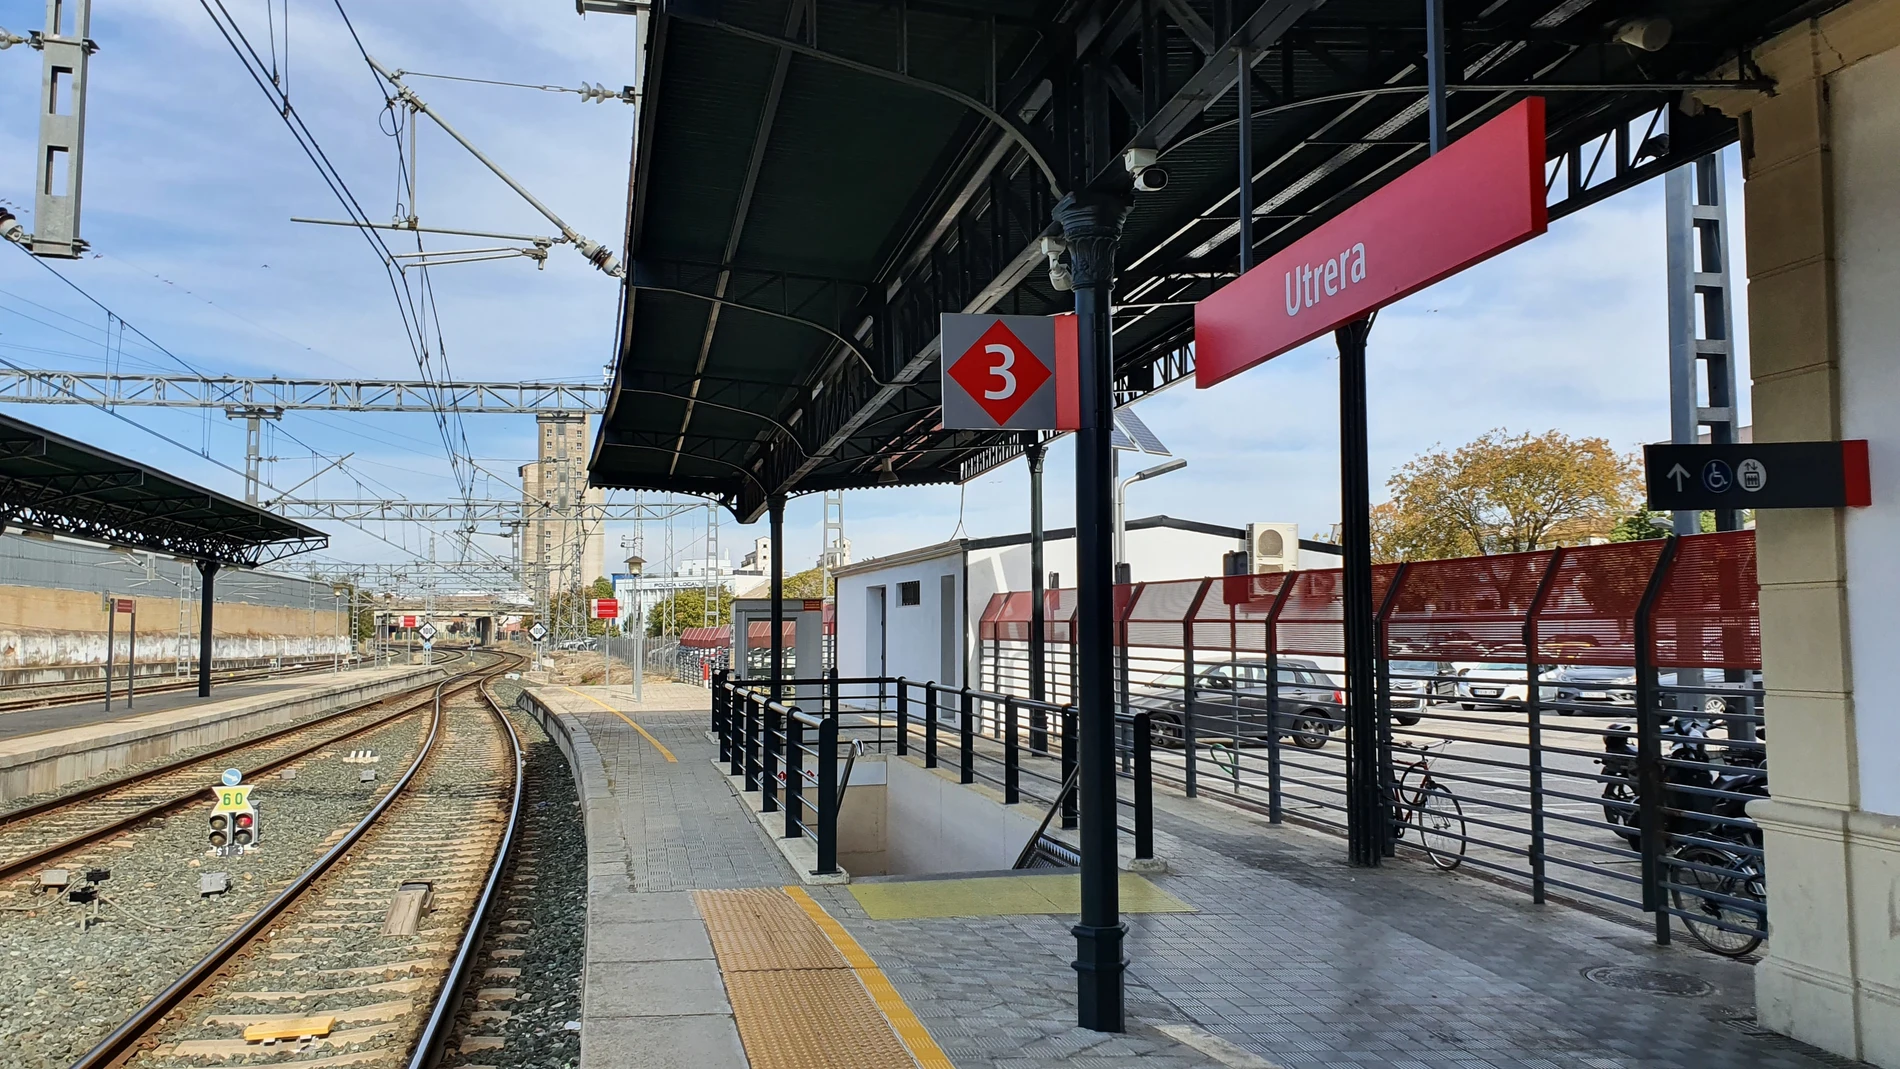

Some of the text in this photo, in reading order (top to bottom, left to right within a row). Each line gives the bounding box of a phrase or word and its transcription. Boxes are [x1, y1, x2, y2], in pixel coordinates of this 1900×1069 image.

[1285, 242, 1366, 317] Utrera
[984, 343, 1017, 400] 3
[422, 627, 433, 635] 100
[533, 627, 543, 635] 100
[223, 792, 243, 806] 60
